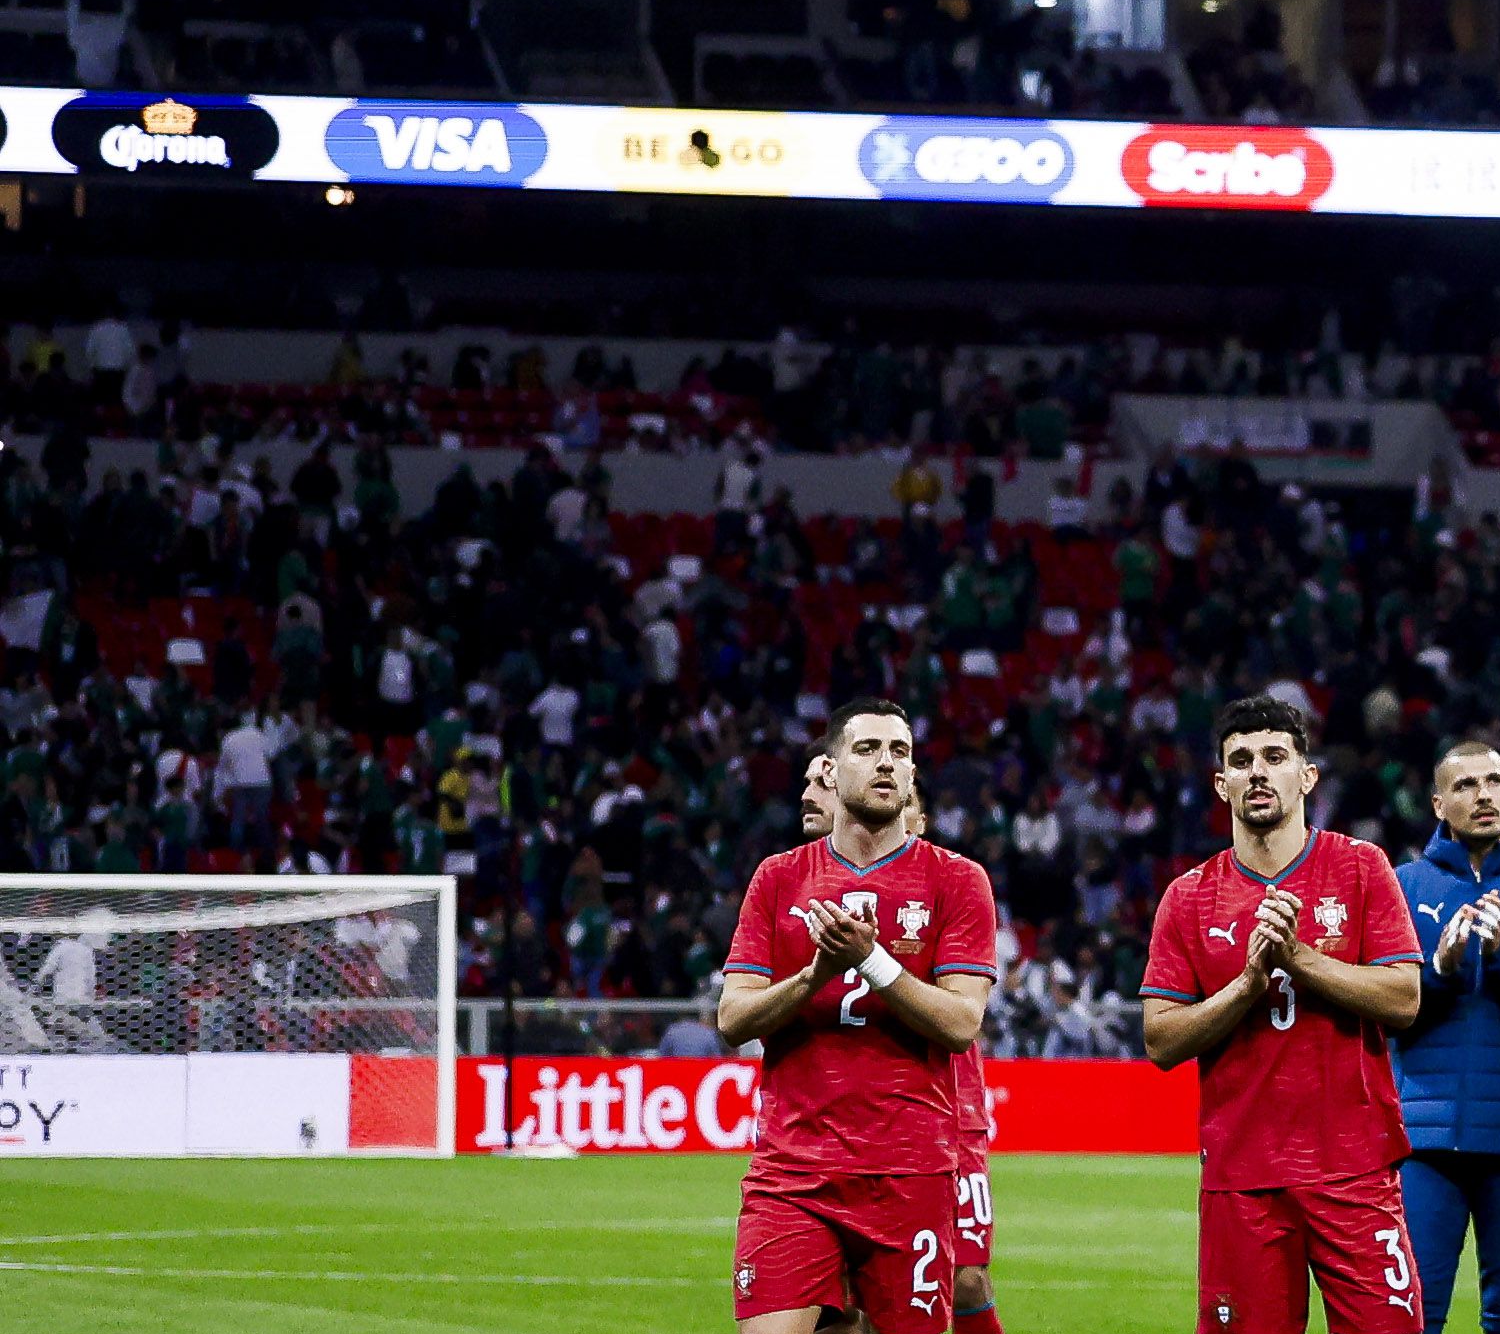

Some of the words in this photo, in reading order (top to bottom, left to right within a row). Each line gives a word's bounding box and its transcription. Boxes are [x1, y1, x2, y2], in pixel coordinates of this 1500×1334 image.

[100, 124, 231, 172] Corona
[361, 114, 513, 174] VISA
[840, 966, 871, 1026] 2
[1270, 967, 1296, 1031] 3
[475, 1063, 688, 1150] Little
[912, 1228, 939, 1293] 2
[1374, 1227, 1410, 1291] 3
